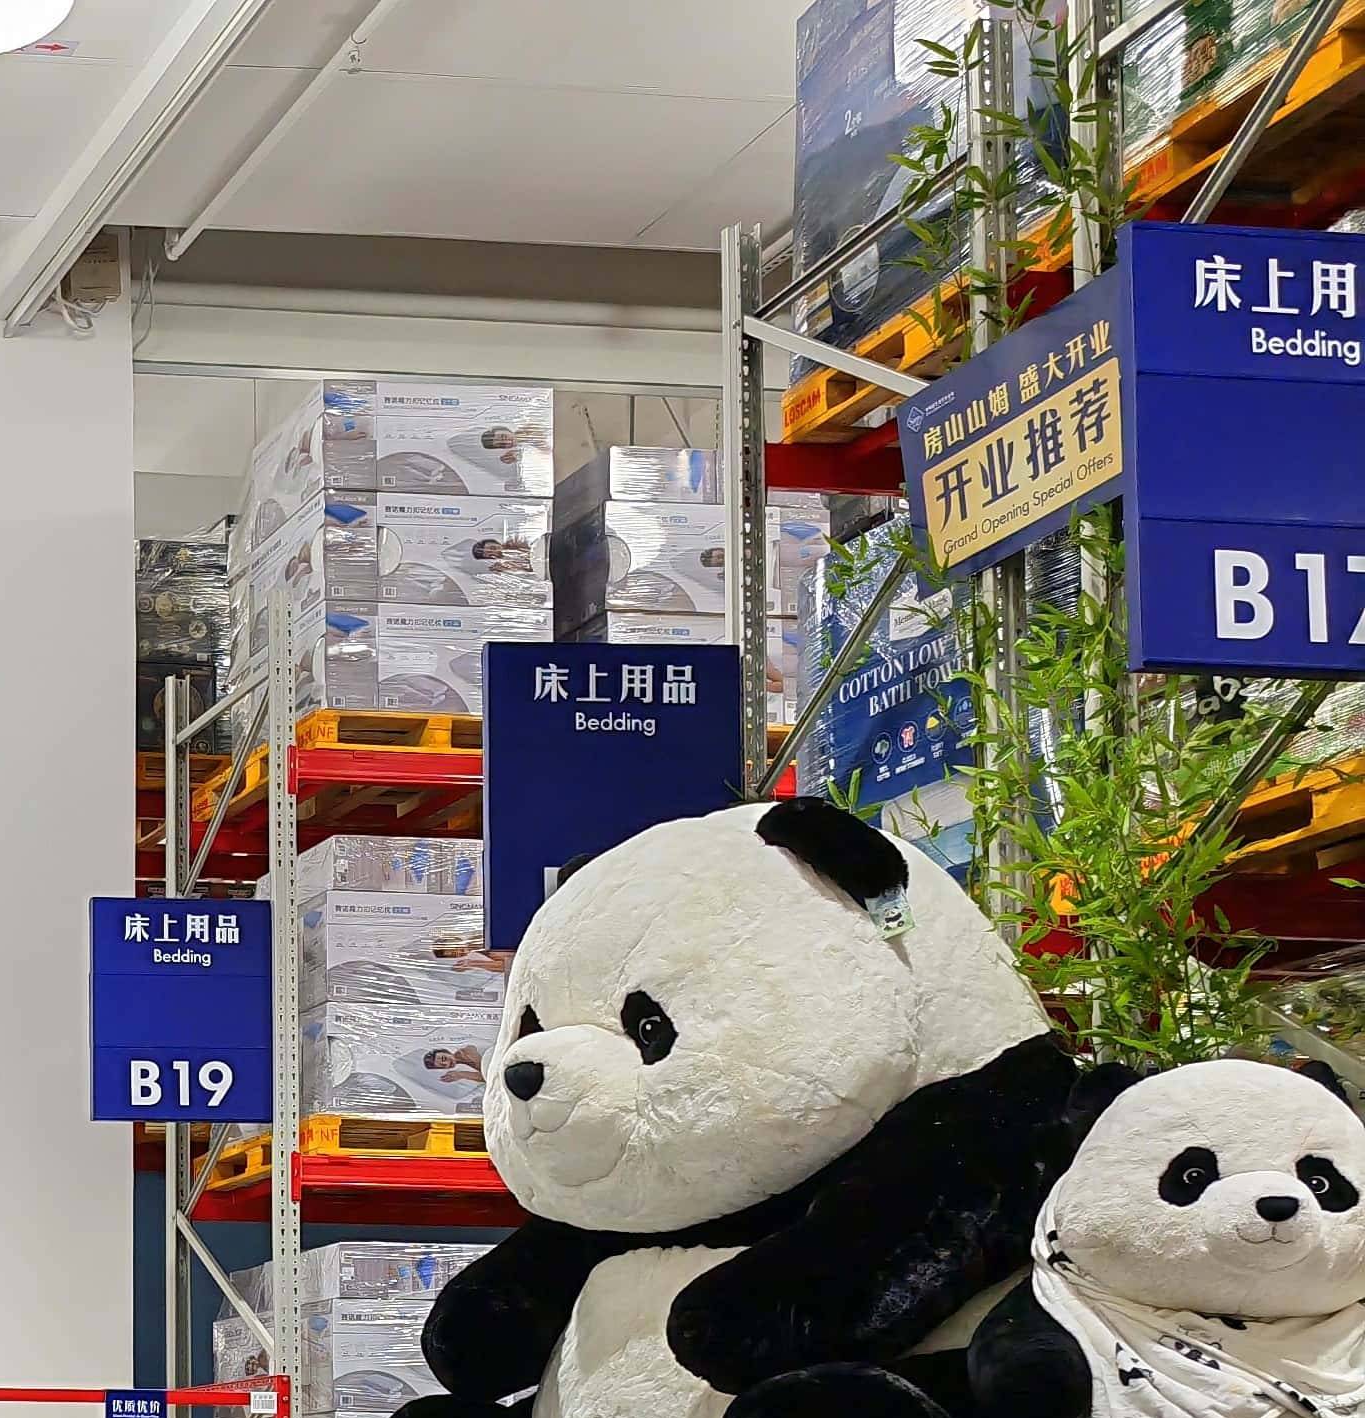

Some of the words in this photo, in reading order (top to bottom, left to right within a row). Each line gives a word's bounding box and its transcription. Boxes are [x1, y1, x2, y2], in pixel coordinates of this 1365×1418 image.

[1194, 254, 1358, 318] 床上用
[1251, 327, 1361, 366] Bedding
[784, 388, 821, 430] LOSCAM
[923, 382, 1010, 461] 房山山姆
[1019, 320, 1113, 404] 盛大开业
[934, 377, 1112, 533] 开业推荐
[943, 527, 978, 555] Grand
[981, 500, 1030, 534] Opening
[1033, 472, 1074, 507] Special
[1076, 452, 1114, 482] Offers
[533, 663, 697, 707] 床上用品
[839, 654, 905, 704] COTTON
[318, 727, 334, 737] NF
[574, 710, 656, 736] Bedding
[123, 912, 240, 946] 床上用品
[153, 947, 212, 968] Bedding
[129, 1060, 233, 1107] B19
[321, 1131, 338, 1141] NF
[112, 1399, 160, 1414] 优质优价
